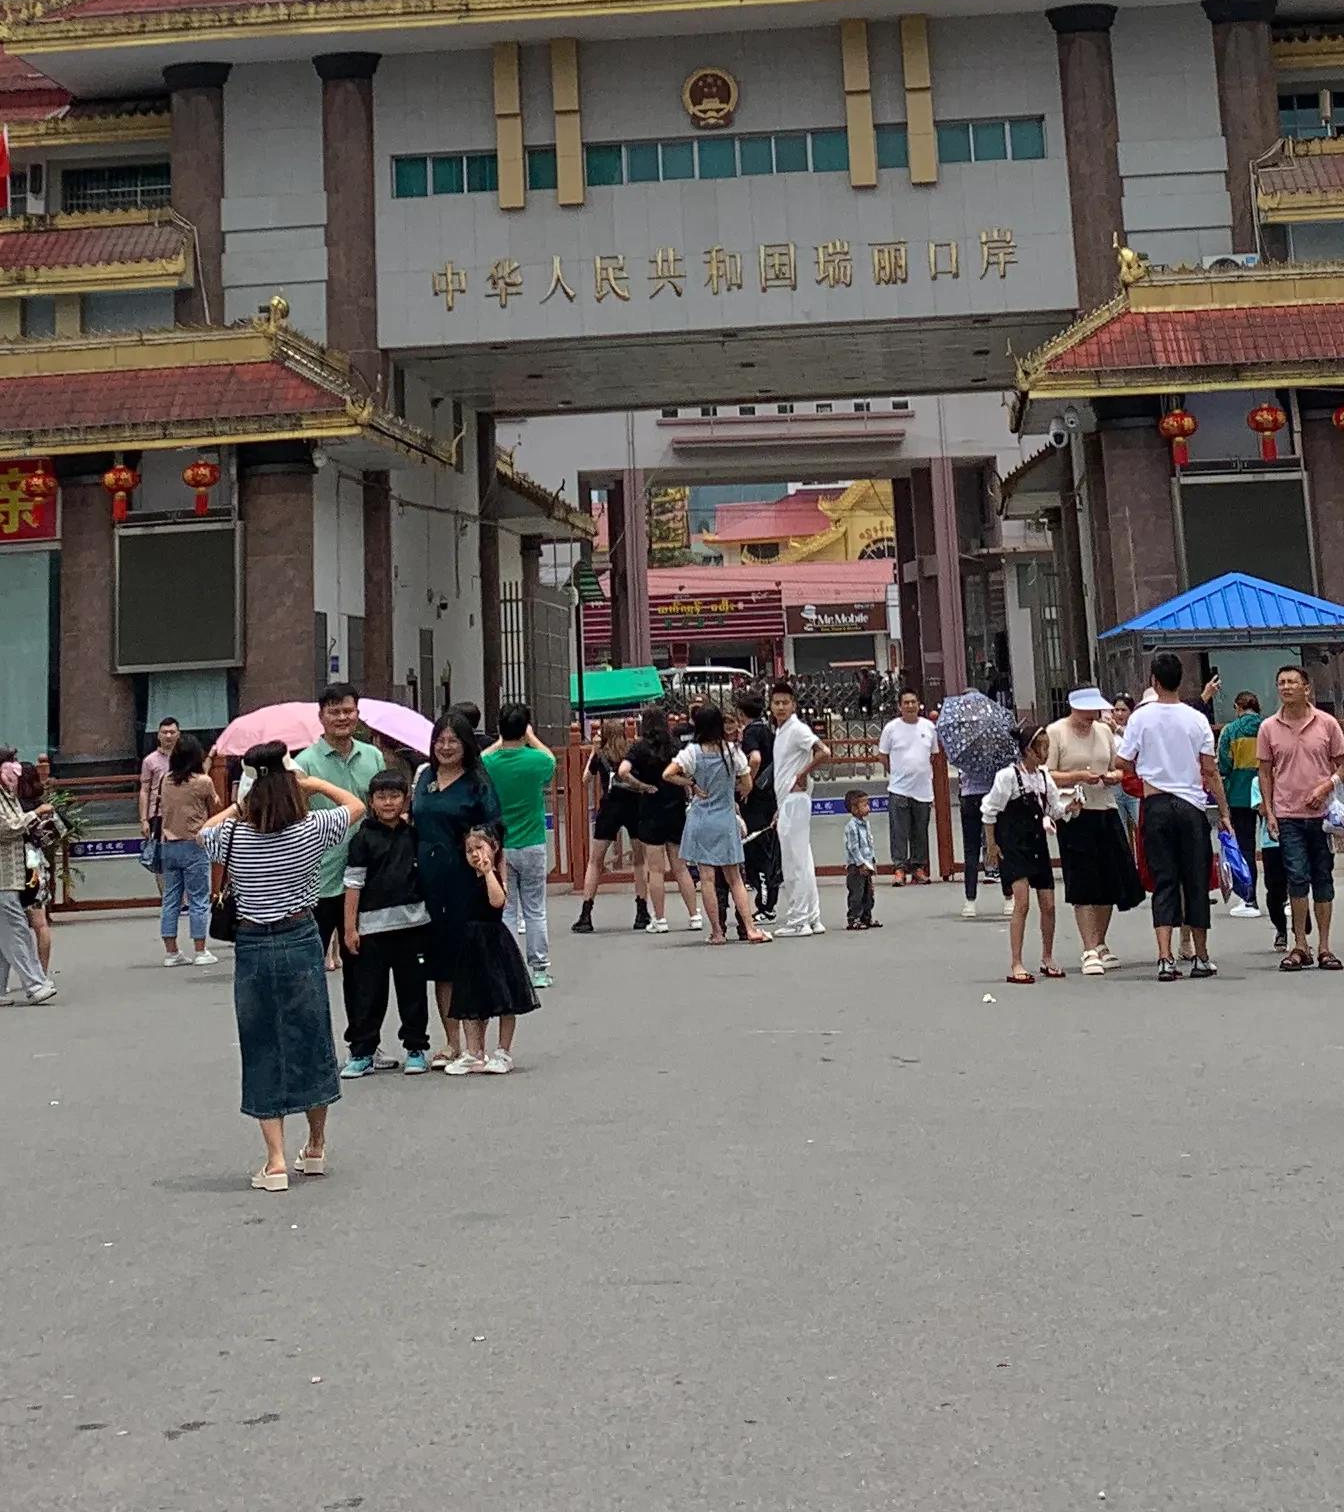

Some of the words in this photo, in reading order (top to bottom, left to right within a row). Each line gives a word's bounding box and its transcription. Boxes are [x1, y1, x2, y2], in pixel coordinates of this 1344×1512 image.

[432, 226, 1019, 312] 中华人民共和国瑞丽口岸
